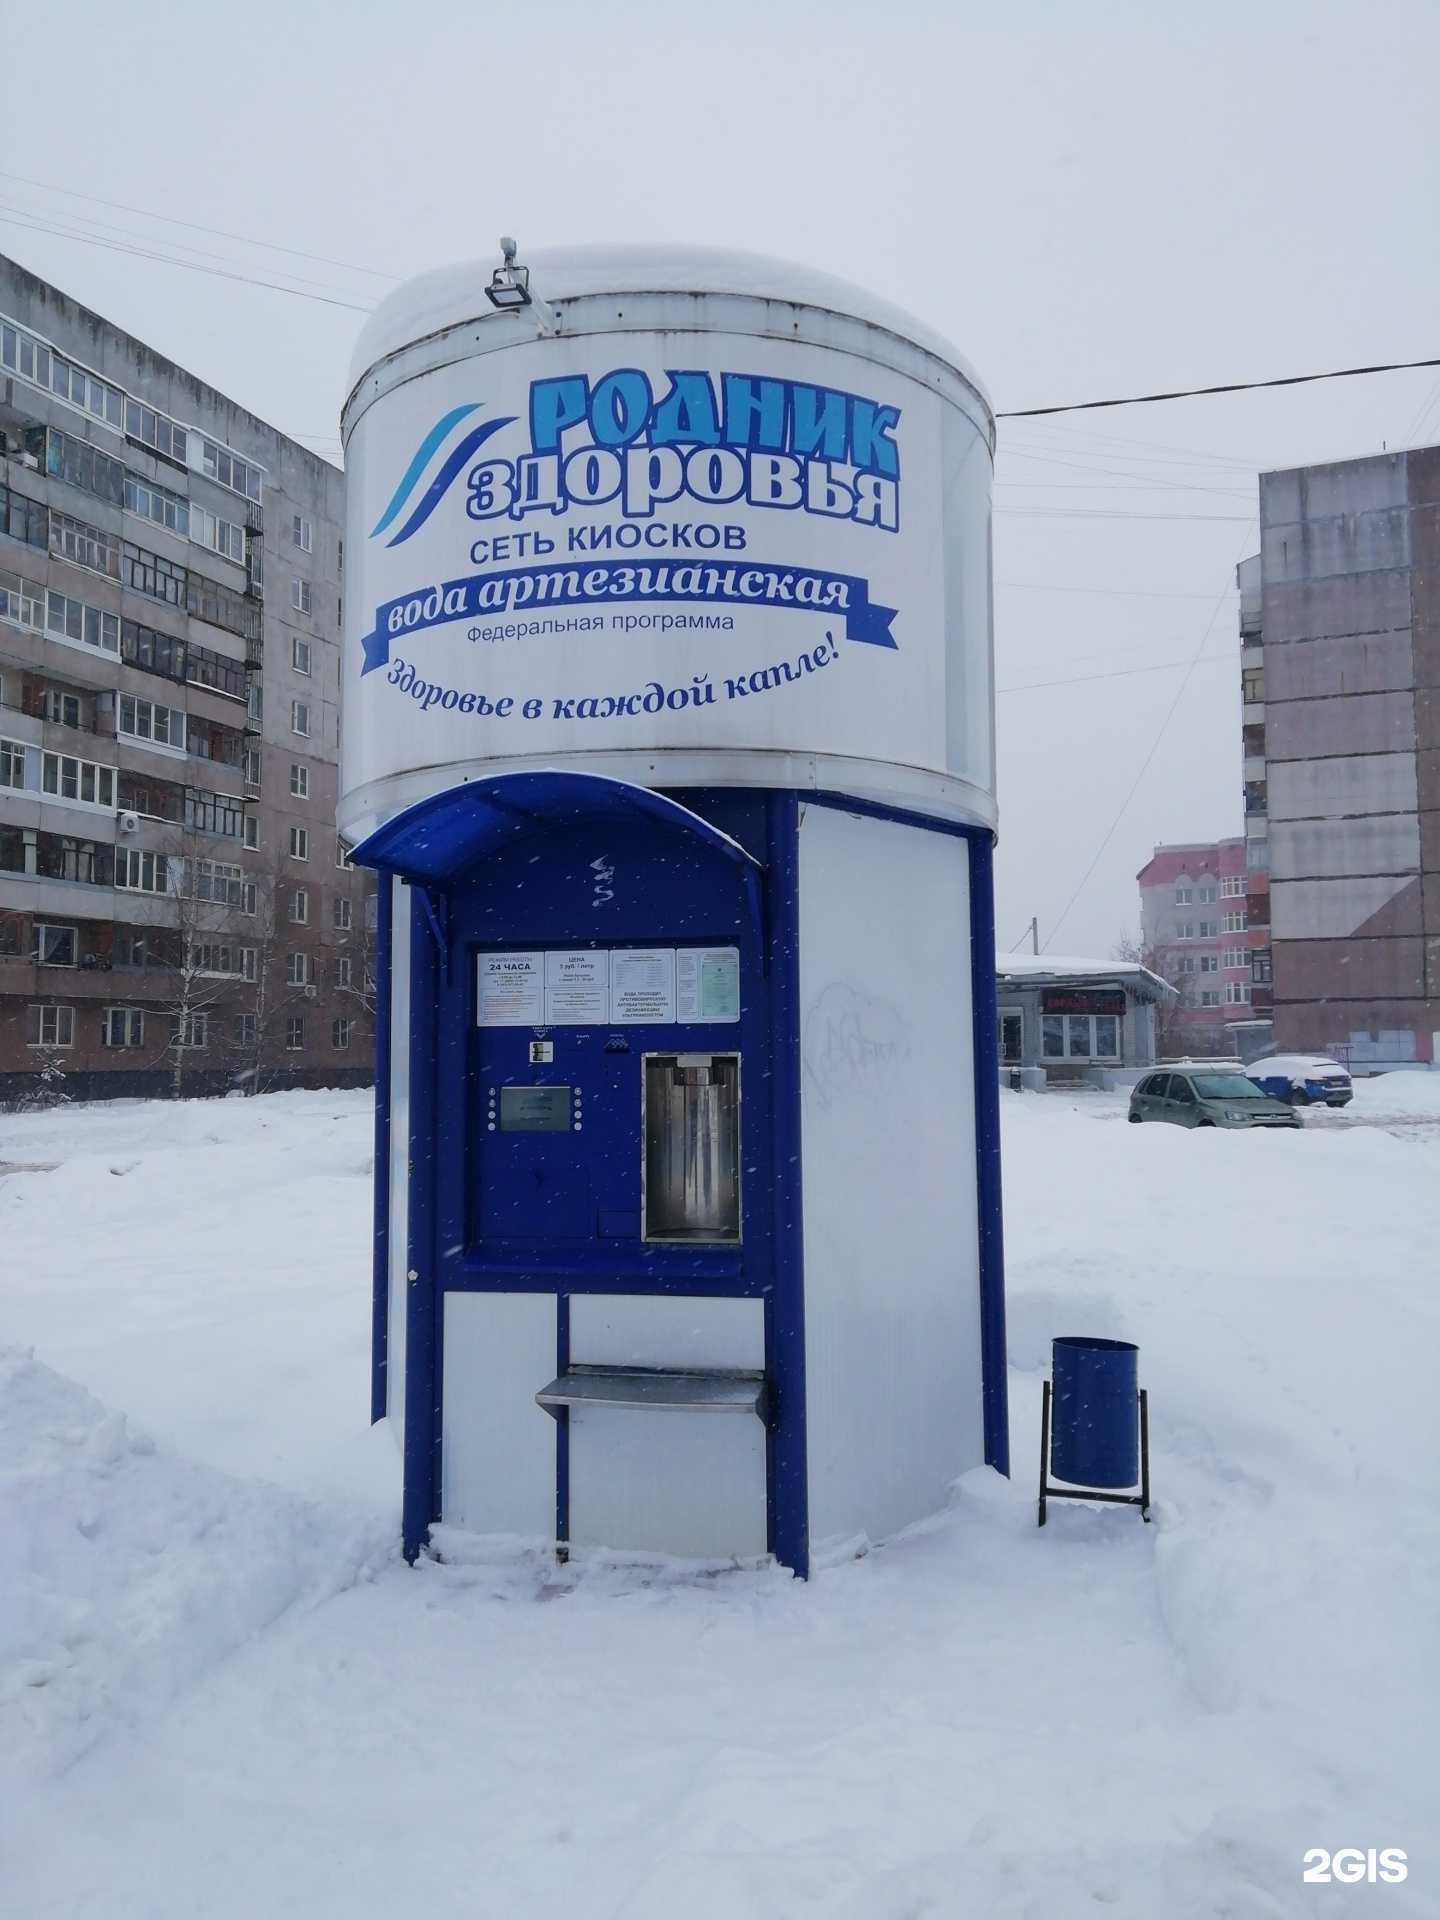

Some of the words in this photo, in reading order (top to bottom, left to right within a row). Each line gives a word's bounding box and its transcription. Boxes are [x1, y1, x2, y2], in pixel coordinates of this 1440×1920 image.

[530, 368, 901, 478] РОДНИК
[470, 530, 556, 564] СЕТЬ
[567, 522, 747, 552] КИОСКОВ
[387, 584, 468, 633] вода
[478, 566, 851, 612] артезианская
[467, 614, 604, 643] Федеральная
[612, 614, 734, 633] программа
[387, 657, 514, 718] Здоровье
[522, 698, 543, 719] в
[552, 672, 717, 719] каждой
[723, 631, 840, 699] капле!
[489, 963, 501, 971] 24
[504, 963, 531, 971] ЧАСА
